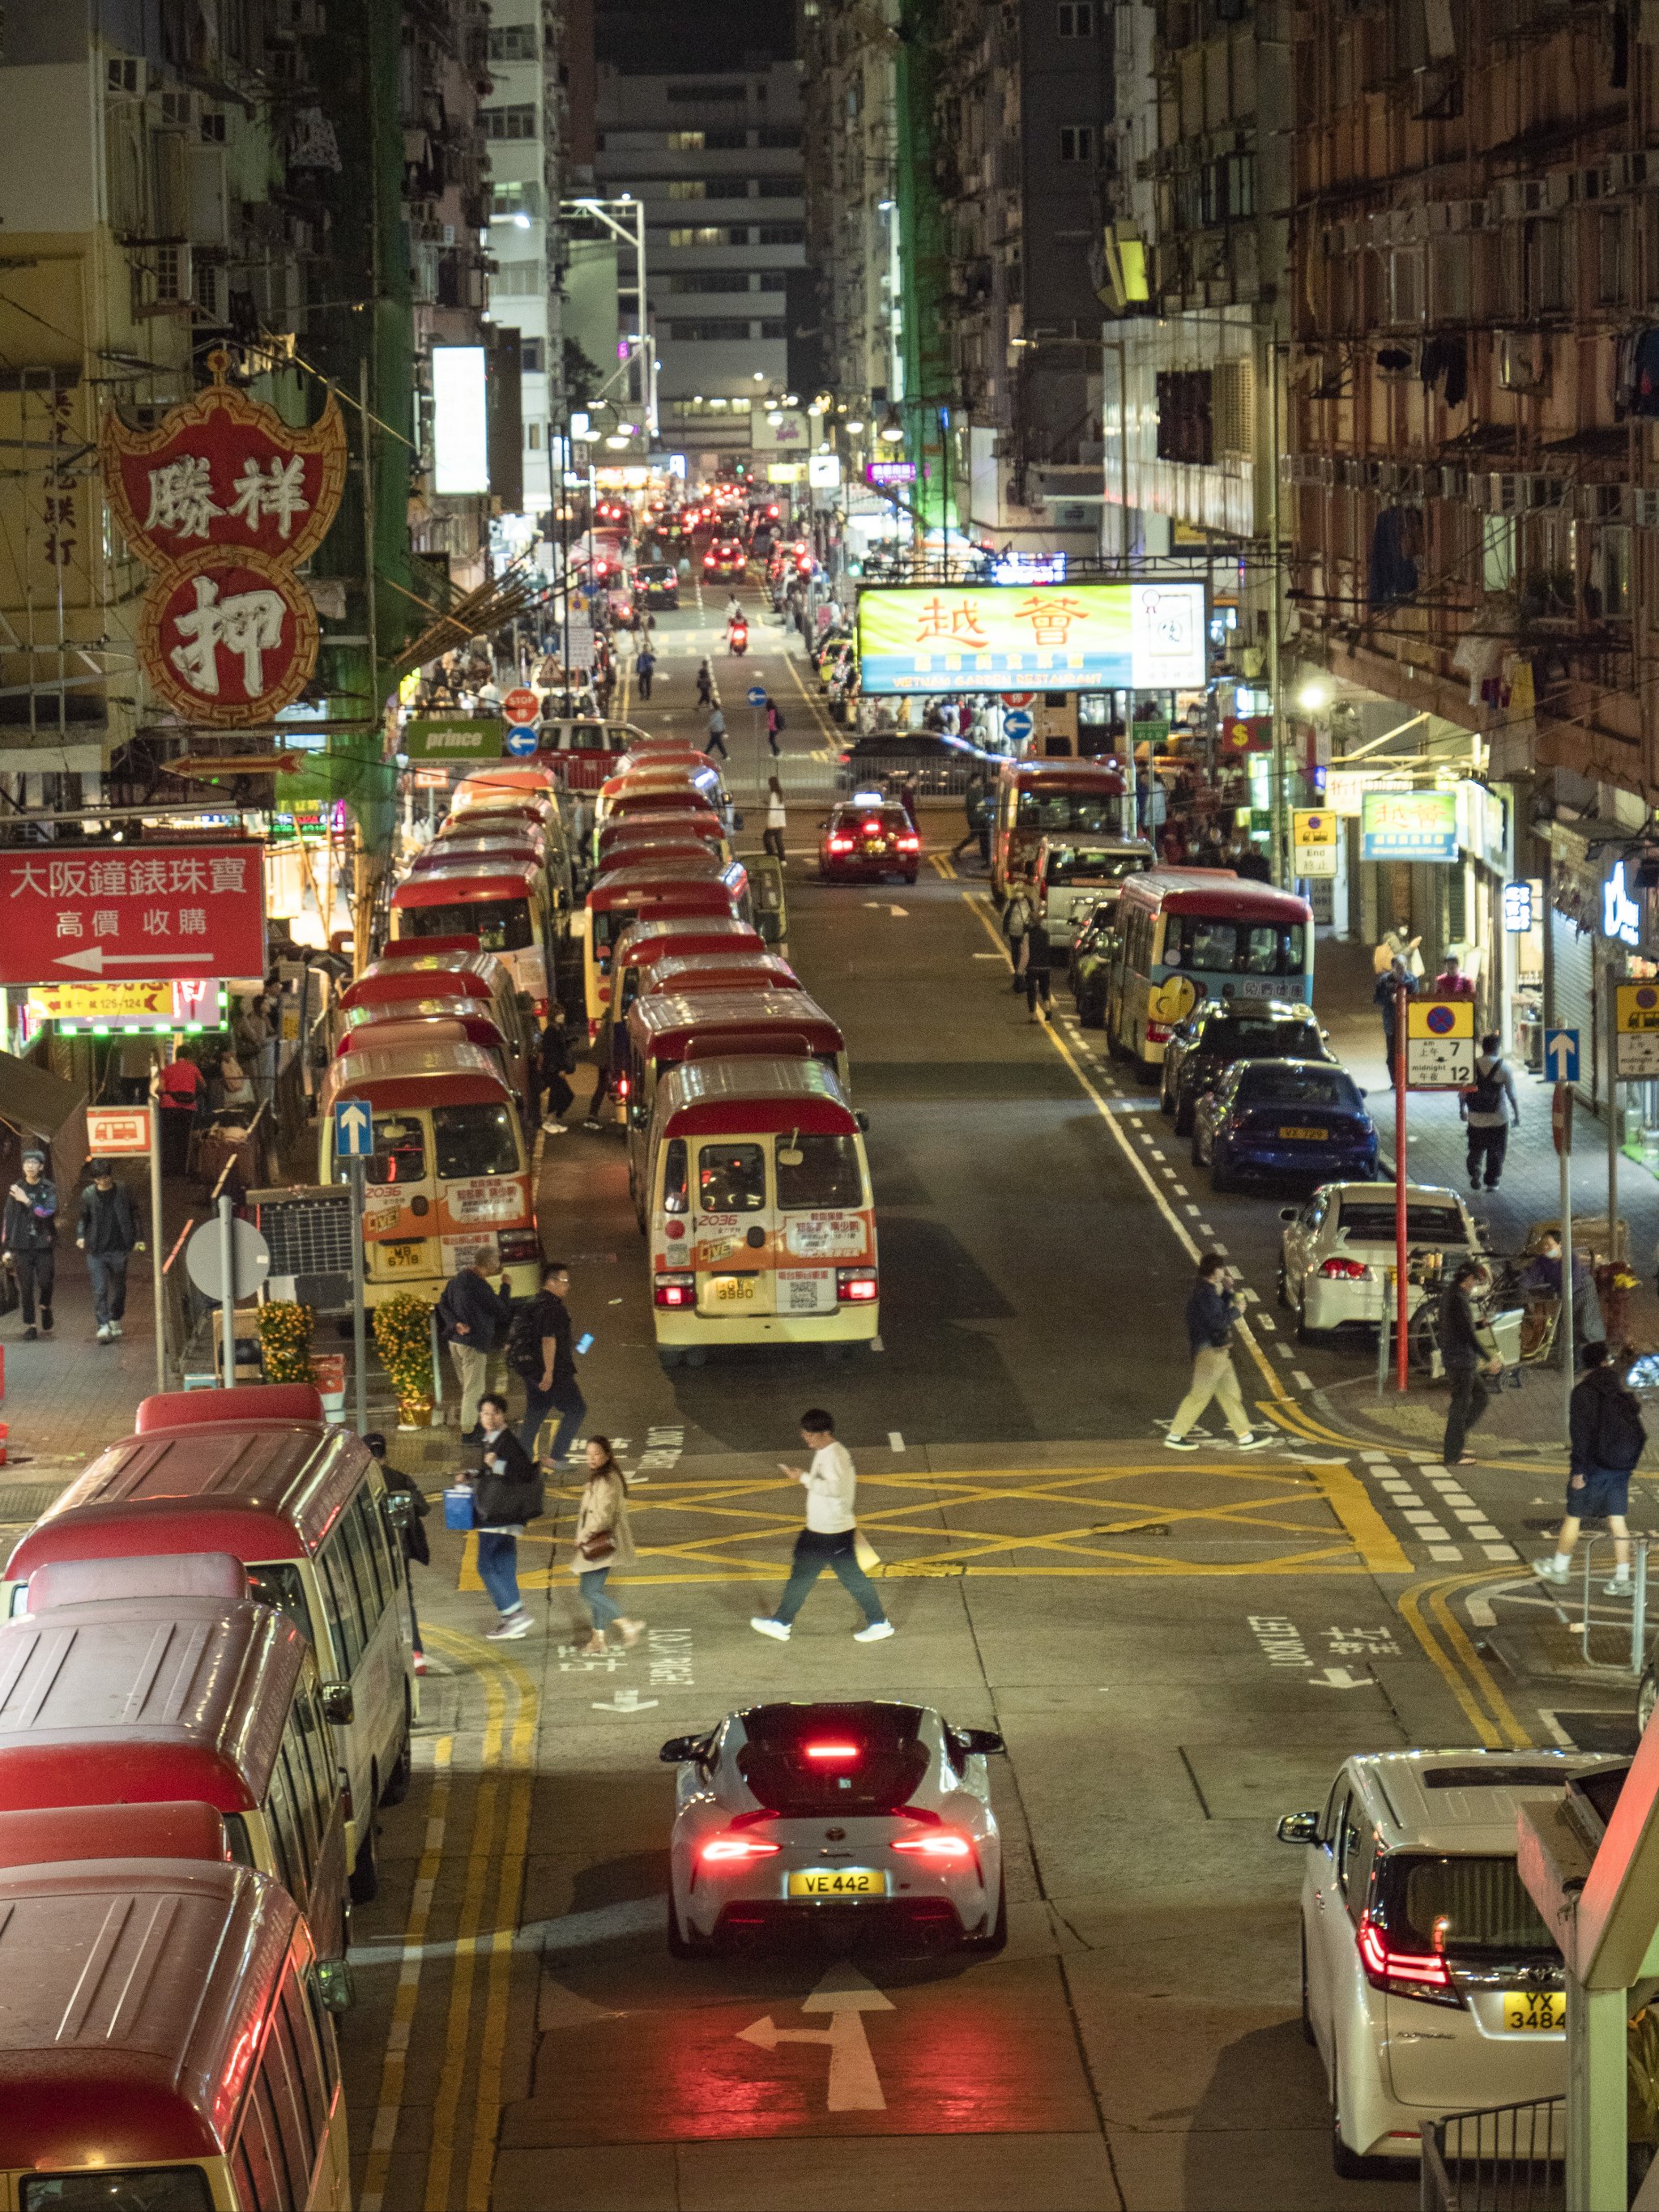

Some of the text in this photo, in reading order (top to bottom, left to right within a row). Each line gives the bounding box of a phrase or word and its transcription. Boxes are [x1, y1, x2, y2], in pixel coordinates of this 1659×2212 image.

[169, 575, 288, 698] 押
[509, 696, 534, 704] STOP
[1307, 848, 1325, 857] End
[1303, 859, 1328, 871] 終止
[10, 857, 246, 898] 大阪鐘錶珠寶
[56, 908, 207, 938] 高價 收購
[1419, 1047, 1439, 1057] 上午
[1450, 1042, 1460, 1056] 7
[1419, 1072, 1439, 1080] 午夜
[1451, 1066, 1469, 1080] 12
[366, 1186, 402, 1199] 2036
[698, 1214, 738, 1227] 2036
[638, 1425, 684, 1470] LOOK RIGHT
[1247, 1615, 1316, 1667] LOOK LEFT
[1320, 1626, 1404, 1656] 望左
[648, 1627, 695, 1686] LOOK RIGHT
[804, 1876, 869, 1892] VE 442
[1526, 1993, 1554, 2011] YX
[1510, 2011, 1567, 2029] 3484
